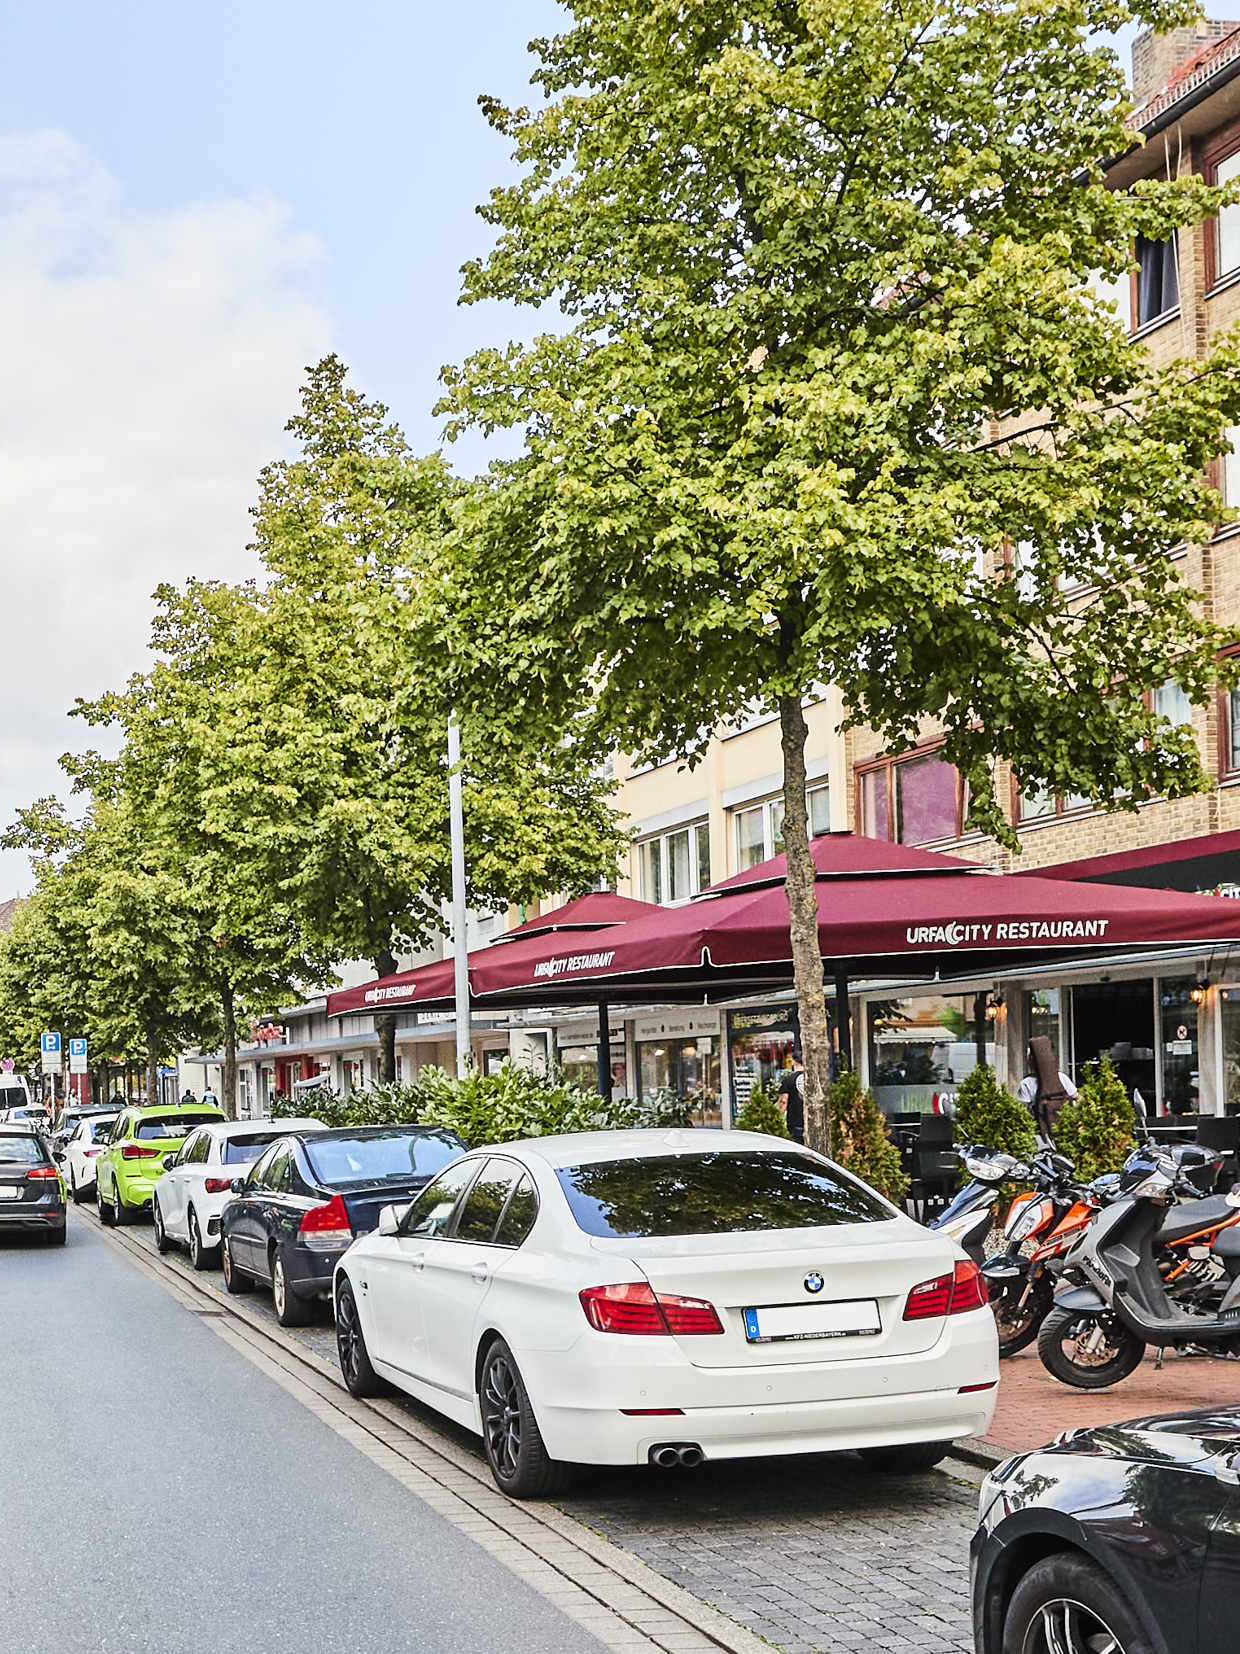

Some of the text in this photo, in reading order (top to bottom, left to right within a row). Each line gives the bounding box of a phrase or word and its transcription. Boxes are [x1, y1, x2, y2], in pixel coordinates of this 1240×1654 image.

[996, 920, 1109, 940] RESTAURANT
[567, 951, 615, 971] RESTAURANT
[386, 984, 416, 999] RESTAURANT
[45, 1035, 57, 1051] P
[73, 1041, 84, 1055] P
[750, 1325, 757, 1333] D
